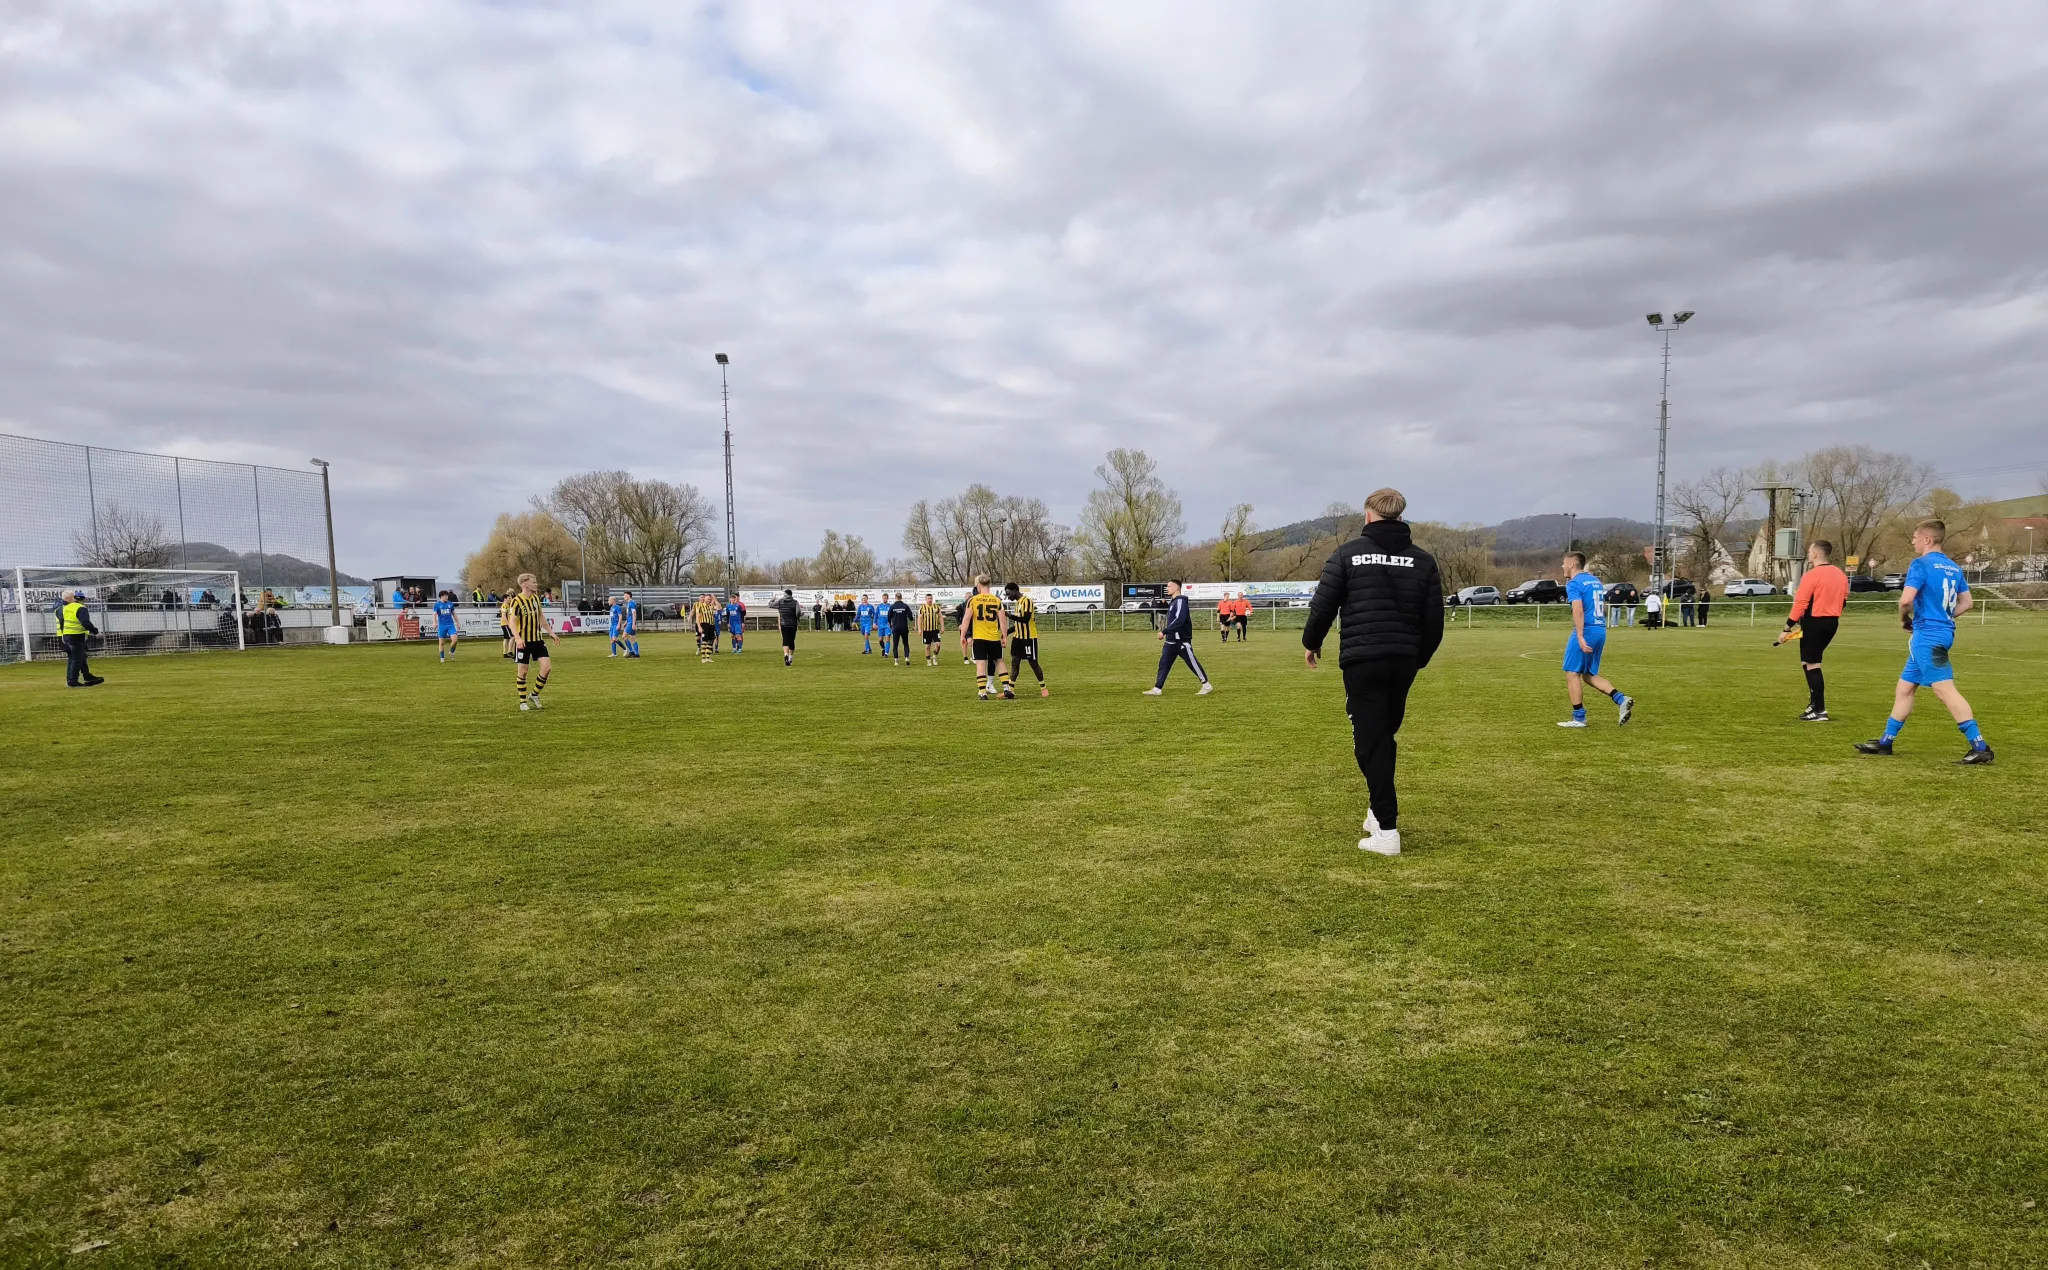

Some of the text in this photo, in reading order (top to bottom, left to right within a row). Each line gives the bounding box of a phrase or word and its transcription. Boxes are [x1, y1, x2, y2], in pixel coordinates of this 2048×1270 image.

[1351, 553, 1414, 568] SCHLEIZ
[937, 588, 953, 597] rebo
[1061, 588, 1101, 598] WEMAG
[977, 604, 998, 622] 15
